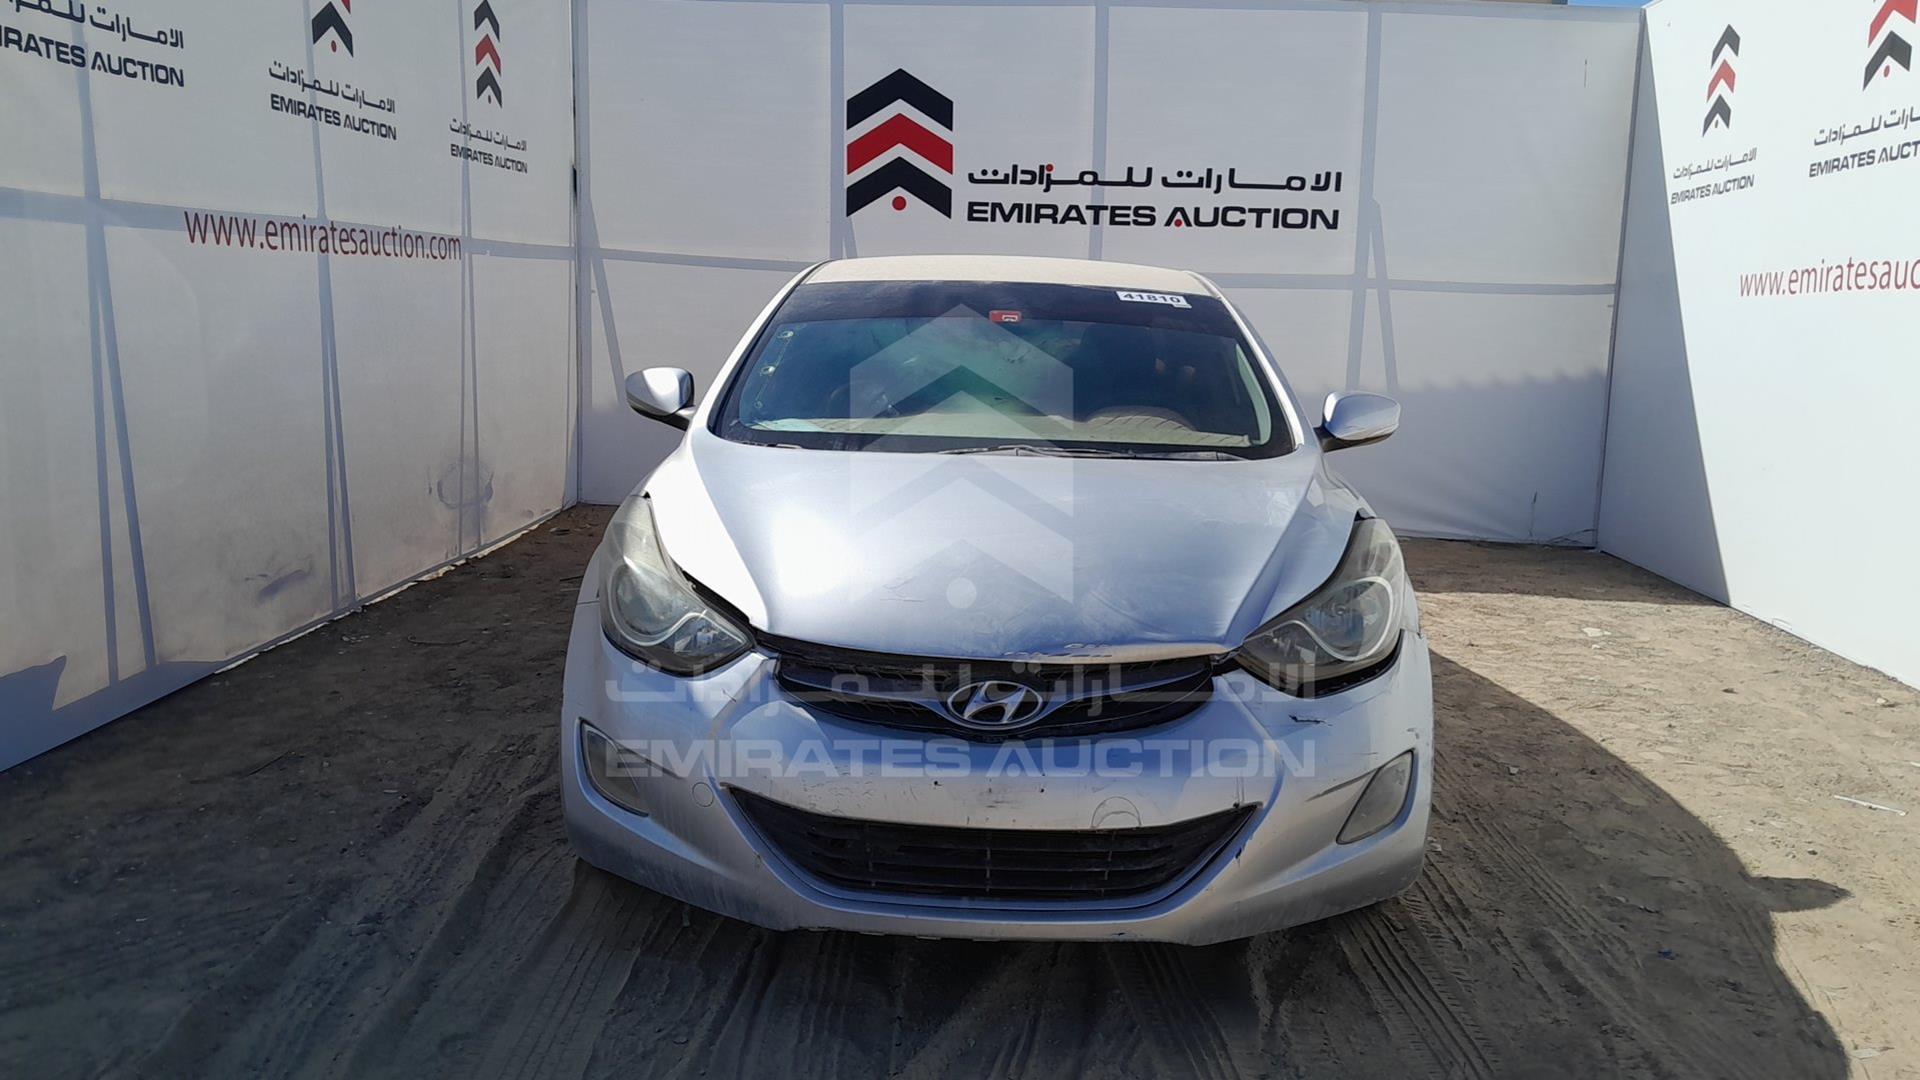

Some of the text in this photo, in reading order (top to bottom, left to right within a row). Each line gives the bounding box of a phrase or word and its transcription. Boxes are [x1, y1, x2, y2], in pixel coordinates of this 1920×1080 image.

[91, 51, 184, 87] AUCTION
[270, 93, 398, 141] EMIRATES AUCTION
[450, 143, 528, 174] EMIRATES AUCTION
[1809, 140, 1920, 178] EMIRATES AUCT
[1670, 174, 1755, 205] EMIRATES AUCTION
[966, 201, 1340, 230] EMIRATES AUCTION
[184, 210, 462, 261] www.emiratesauction.com
[1740, 256, 1920, 297] www.emiratesauc
[1123, 293, 1181, 303] 41810
